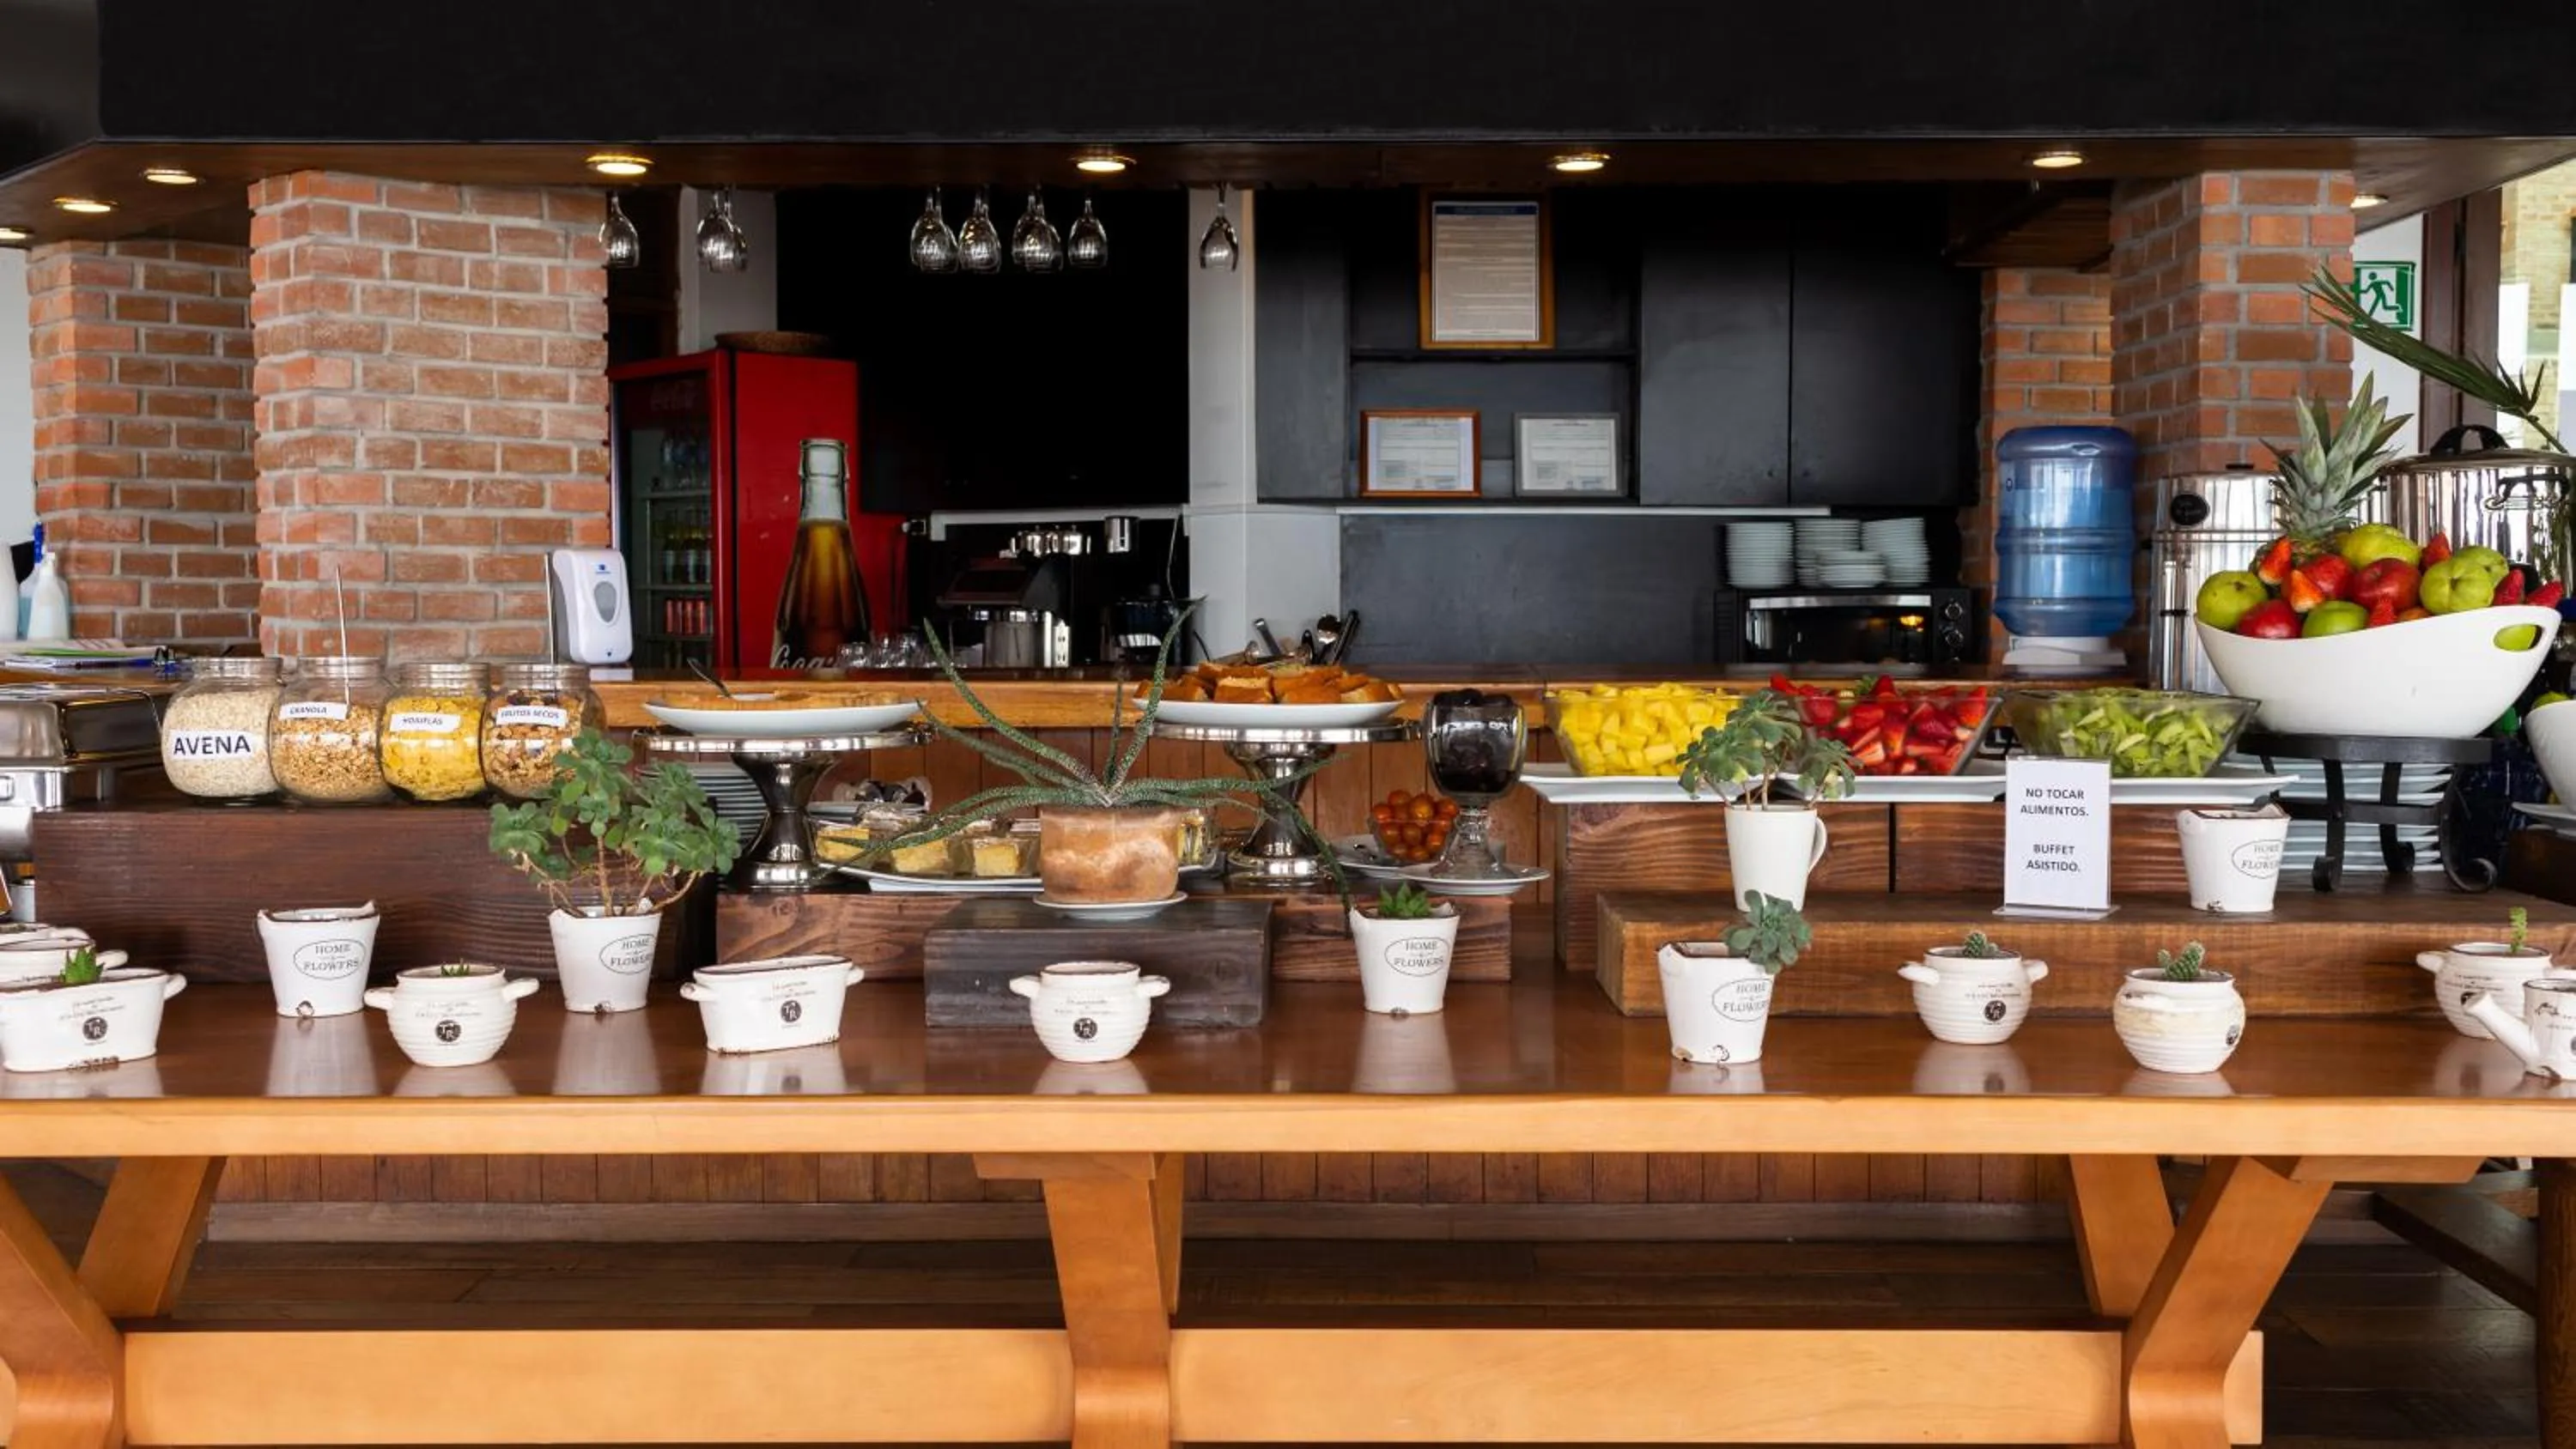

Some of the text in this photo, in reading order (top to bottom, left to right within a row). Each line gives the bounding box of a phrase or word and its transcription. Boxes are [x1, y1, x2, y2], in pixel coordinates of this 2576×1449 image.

[173, 735, 252, 756] AVENA
[2026, 788, 2085, 800] NO TOCAR
[2020, 804, 2089, 816] ALIMENTOS.
[2032, 844, 2075, 856] BUFFET
[2026, 859, 2081, 872] ASISTIDO.
[314, 943, 351, 955] HOME
[1406, 940, 1438, 951] HOME
